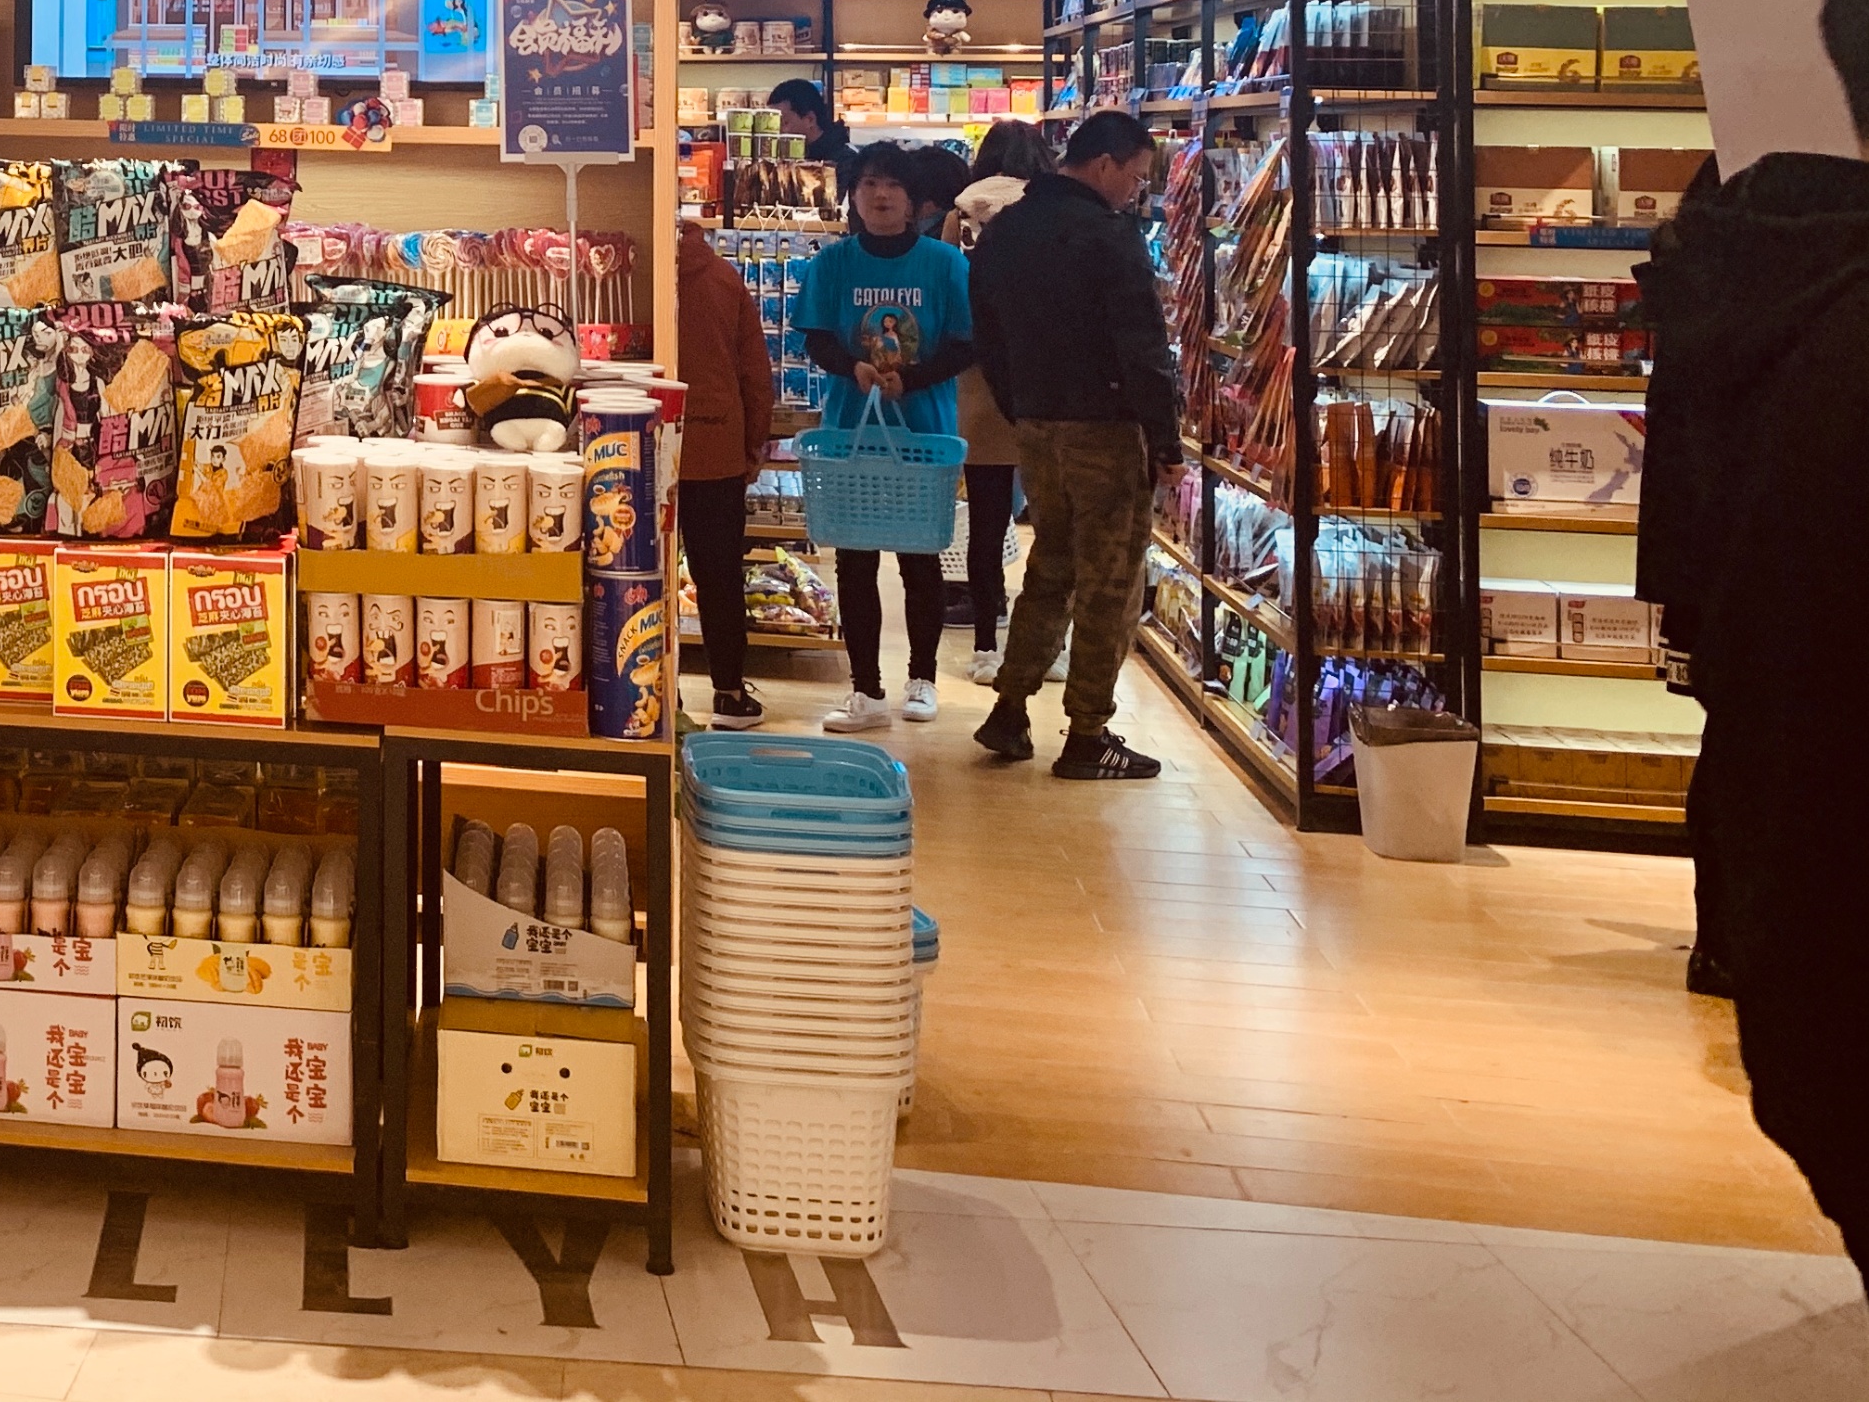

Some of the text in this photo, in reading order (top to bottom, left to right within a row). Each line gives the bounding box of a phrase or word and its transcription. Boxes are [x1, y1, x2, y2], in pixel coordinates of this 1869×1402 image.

[853, 287, 922, 306] CATALEYA
[1549, 449, 1595, 469] 纯牛奶
[76, 581, 147, 608] กรอบ
[193, 585, 262, 612] กรอบ
[475, 689, 554, 722] Chip's
[45, 1023, 67, 1110] 我还是个
[65, 1042, 88, 1096] 宝宝
[284, 1037, 306, 1125] 我还是个
[305, 1055, 328, 1109] 宝宝
